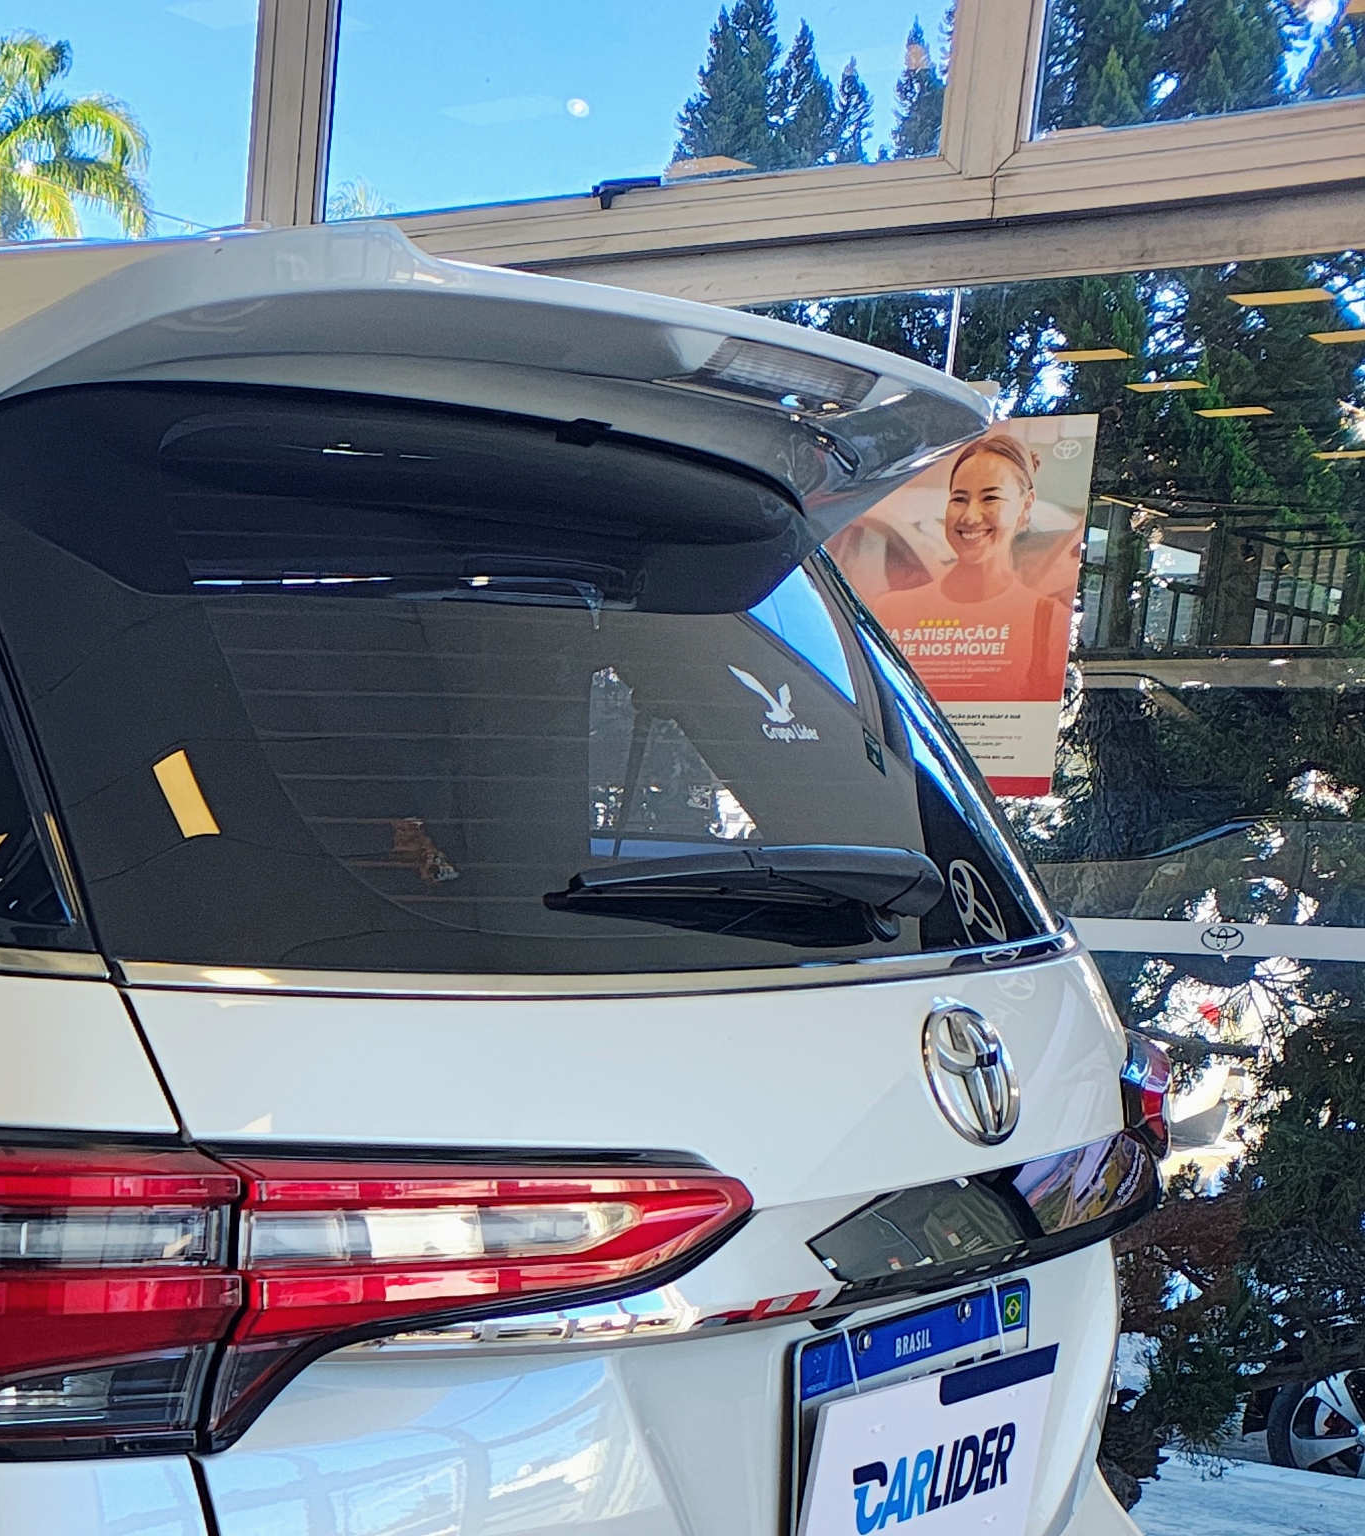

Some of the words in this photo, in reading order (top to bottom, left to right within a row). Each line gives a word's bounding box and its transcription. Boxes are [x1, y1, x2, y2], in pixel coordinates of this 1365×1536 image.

[903, 625, 998, 643] SATISFAÇÃO
[1000, 624, 1010, 640] É
[919, 643, 951, 656] NOS
[954, 642, 1006, 656] MOVE!
[761, 723, 796, 743] Grupo
[894, 1327, 932, 1358] BRASIL
[852, 1421, 1016, 1536] CARLIDER
